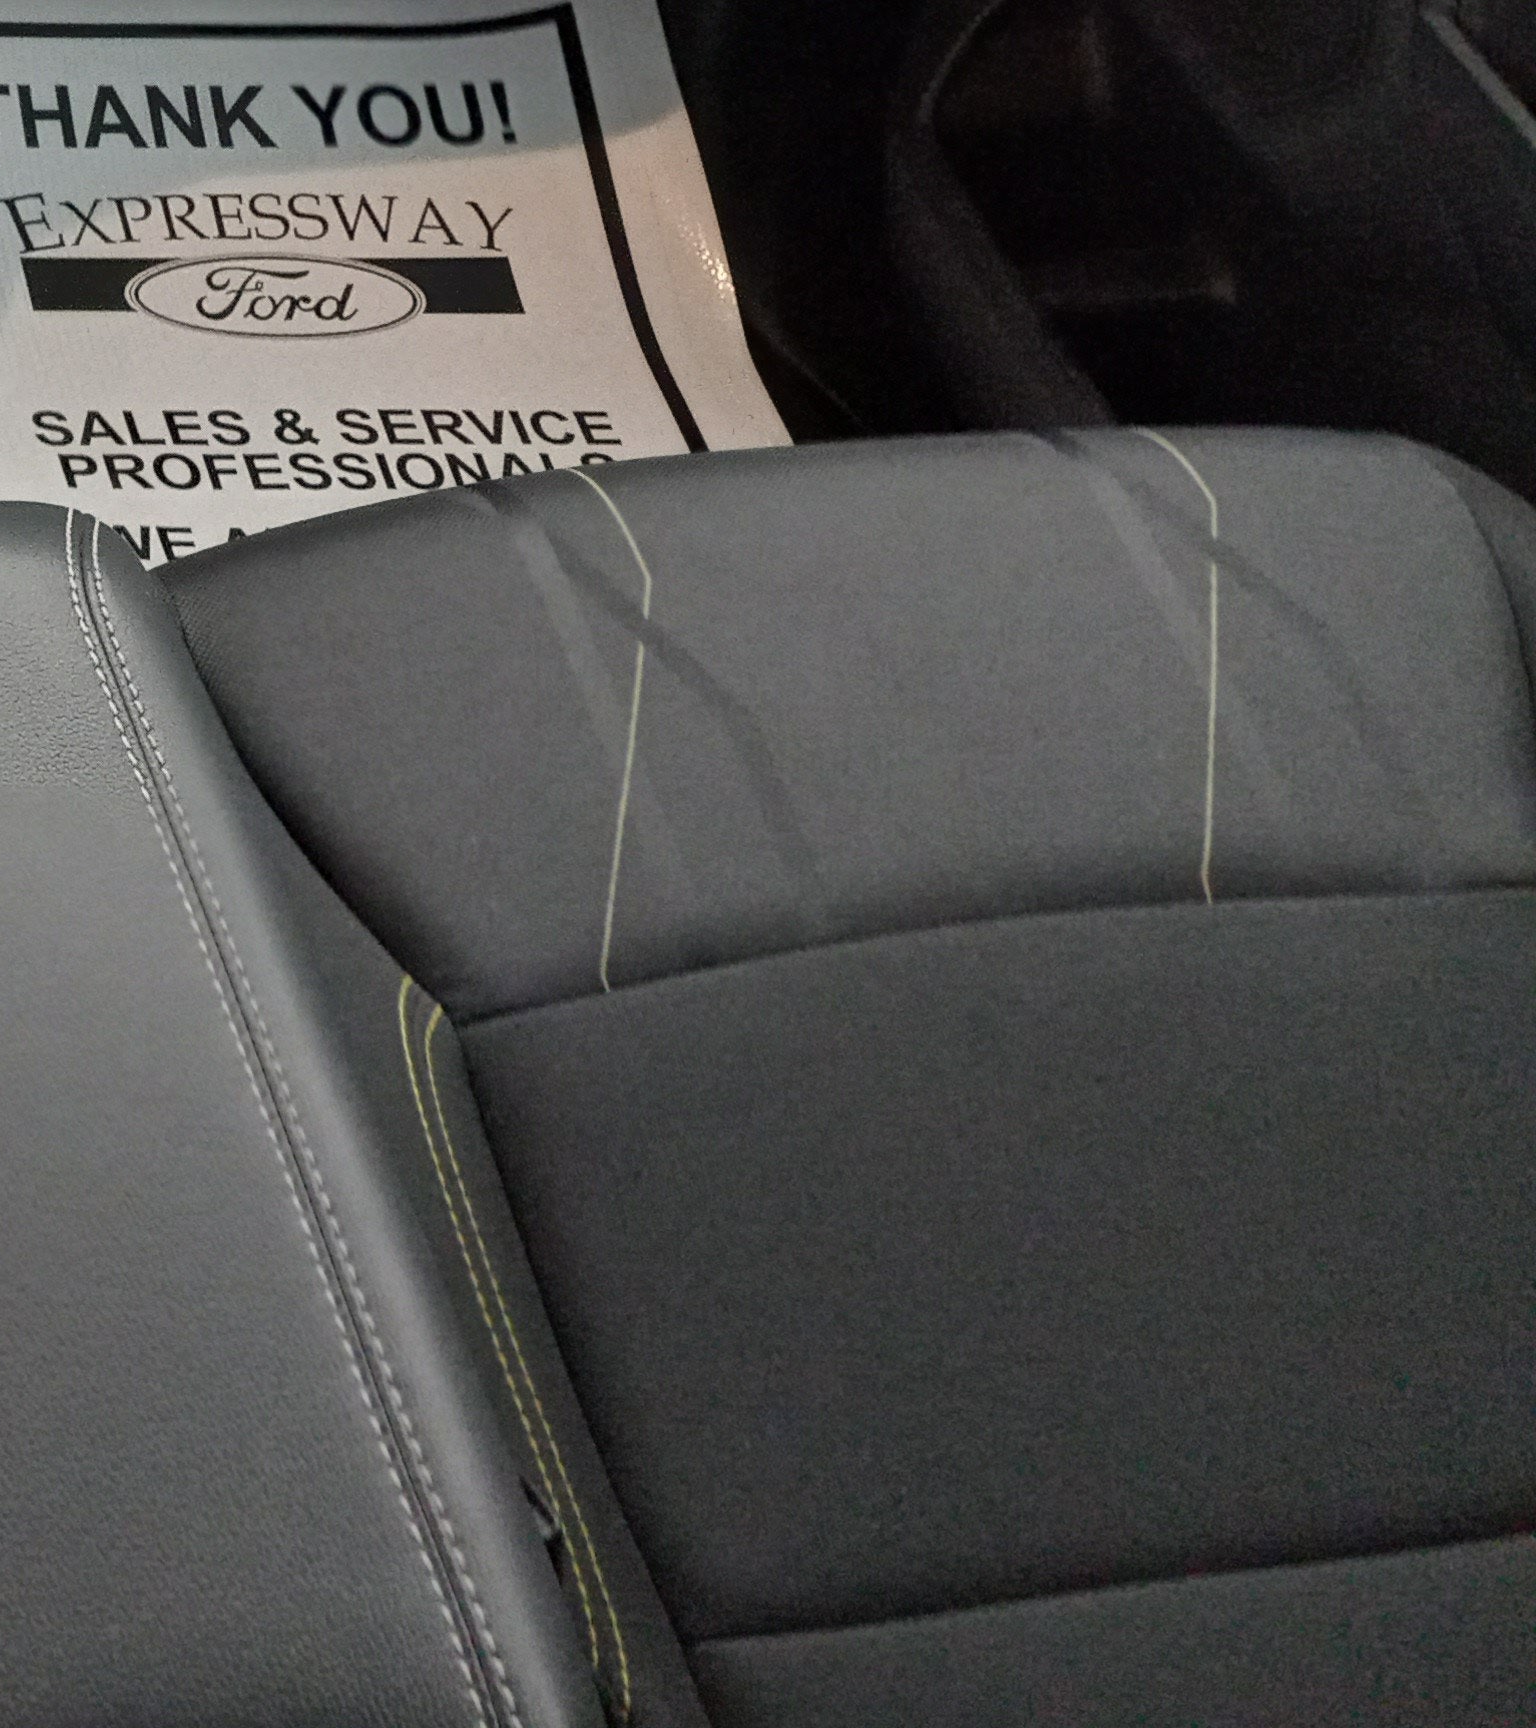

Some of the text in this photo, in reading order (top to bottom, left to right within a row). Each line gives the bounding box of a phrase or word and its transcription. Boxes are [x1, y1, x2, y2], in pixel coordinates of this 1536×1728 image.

[288, 79, 519, 147] YOU!
[194, 266, 358, 326] Ford
[31, 408, 623, 447] SALES & SERVICE
